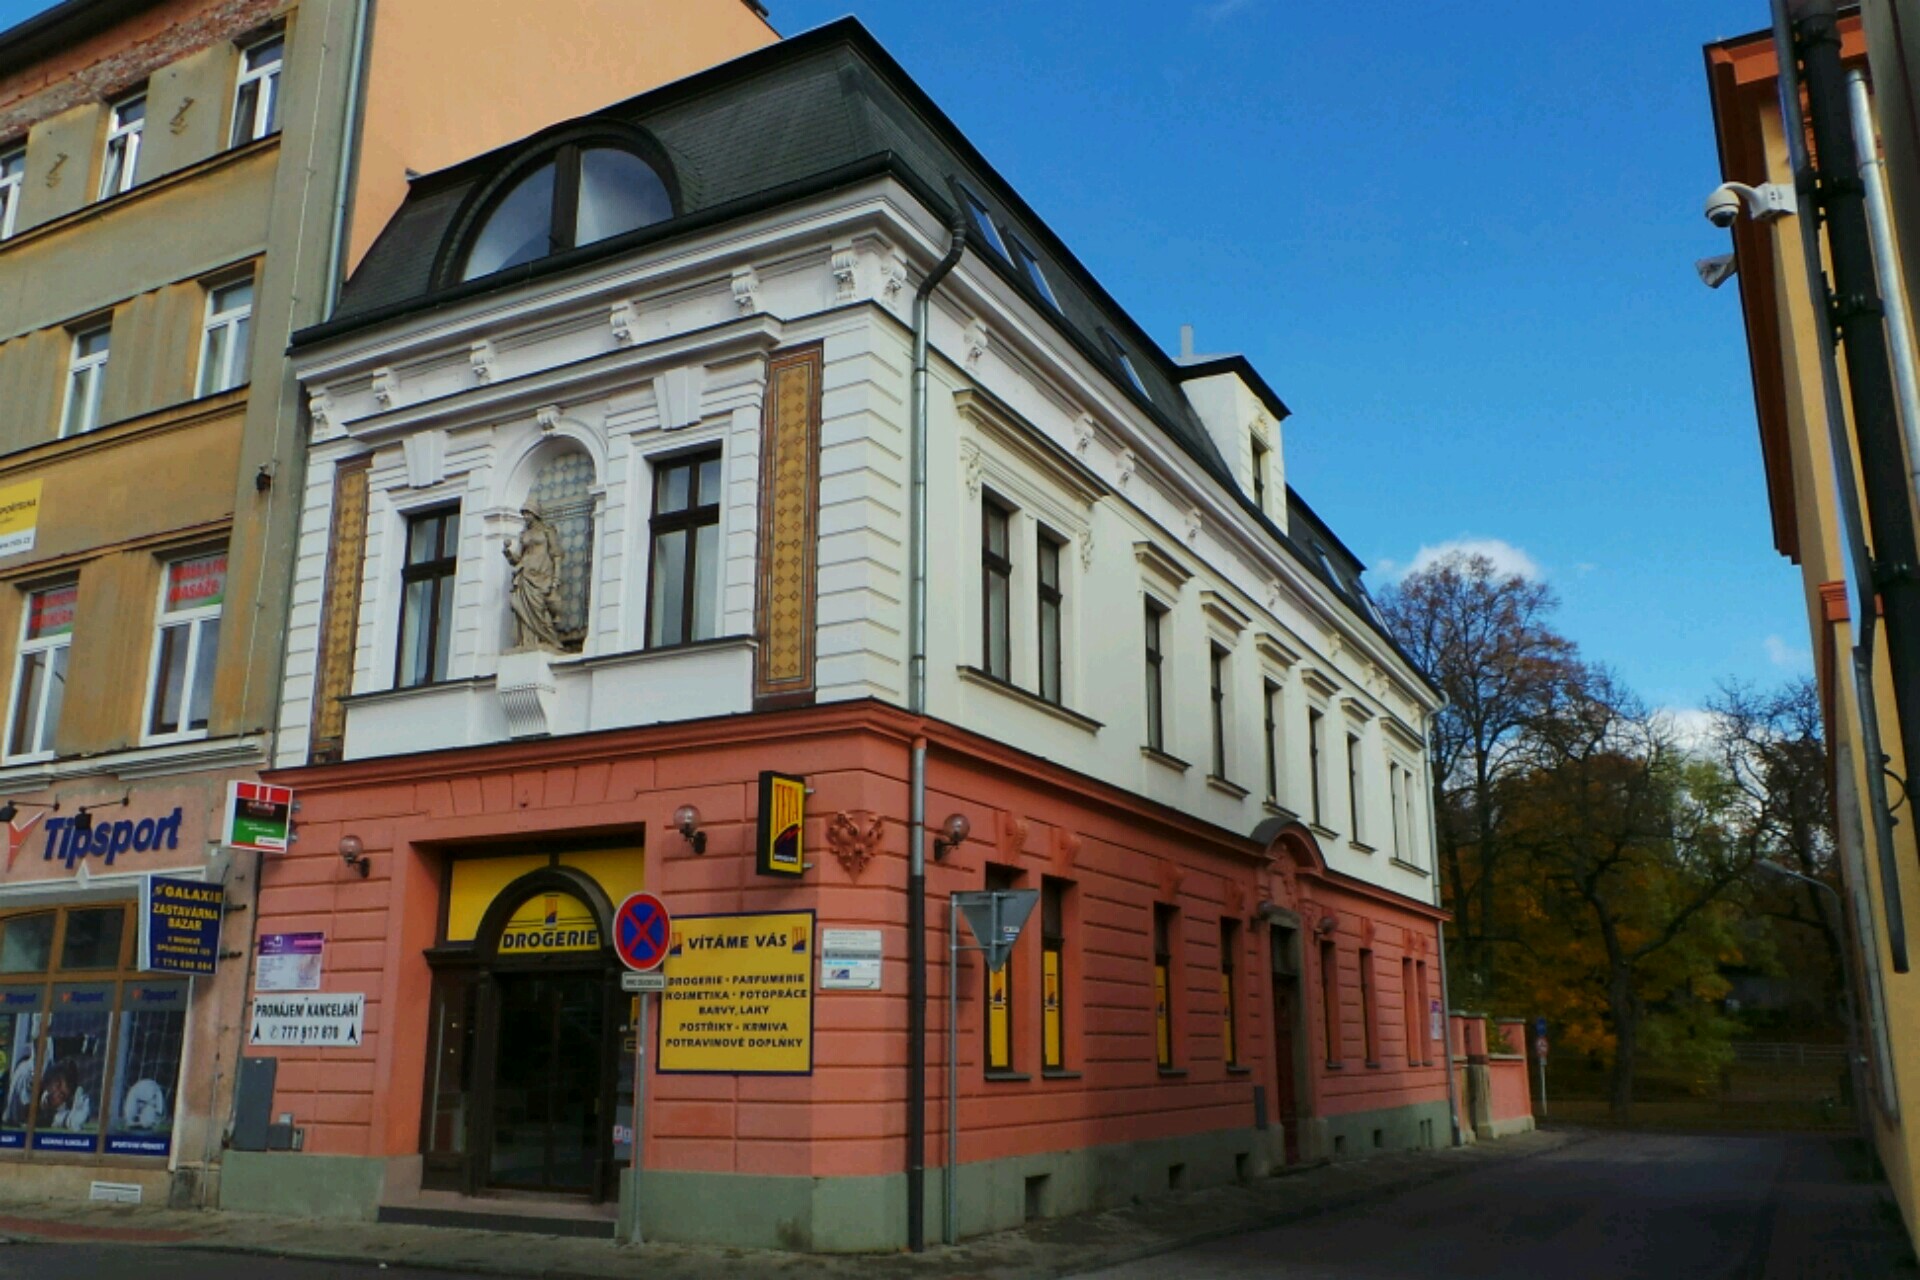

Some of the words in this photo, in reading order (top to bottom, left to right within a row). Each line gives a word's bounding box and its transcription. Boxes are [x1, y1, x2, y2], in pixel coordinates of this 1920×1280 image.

[43, 806, 182, 869] Tipsport
[165, 886, 222, 903] GALAXIE
[503, 930, 598, 949] DROGERIE
[688, 934, 749, 949] VÍTÁME
[755, 932, 787, 947] VÁS
[668, 976, 723, 986] DROGERIE
[732, 974, 805, 984] PARFUMERIE
[665, 990, 730, 1000] KOSMETIKA
[740, 987, 807, 998] FOTOPRÁCE
[255, 1001, 304, 1017] PRONÁJEM
[740, 1006, 770, 1015] LAKY
[282, 1025, 298, 1039] 777
[680, 1021, 733, 1031] POSTŘIKY
[742, 1022, 788, 1031] KRMIVA
[666, 1037, 745, 1047] POTRAVINOVÉ
